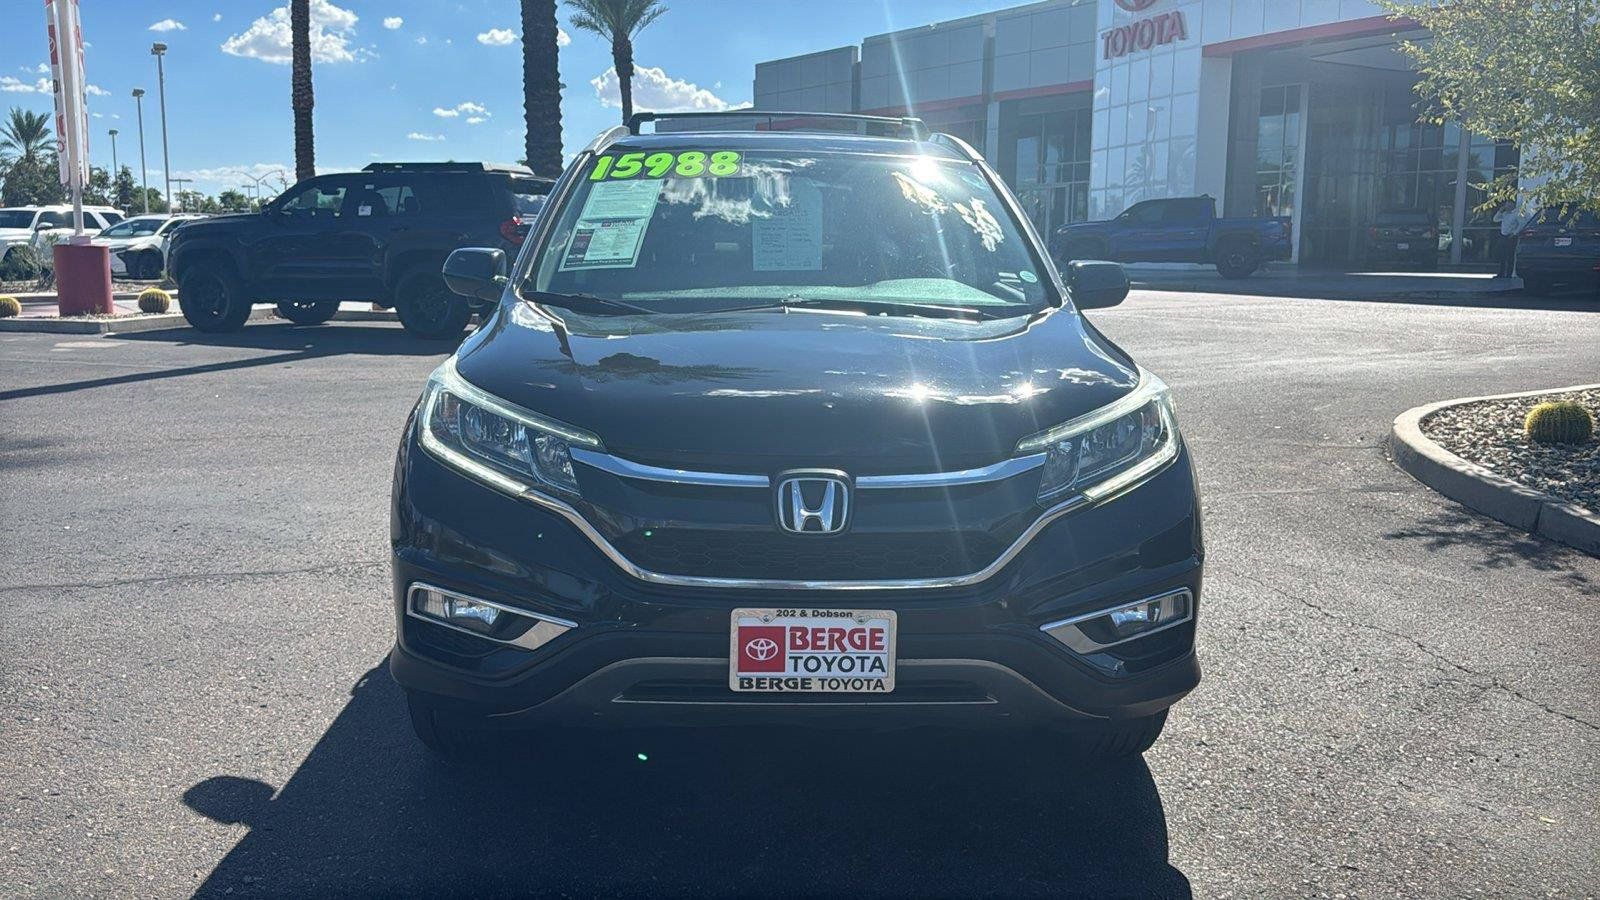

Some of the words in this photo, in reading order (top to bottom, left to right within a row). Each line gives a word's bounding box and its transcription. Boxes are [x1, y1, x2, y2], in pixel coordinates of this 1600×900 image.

[1101, 11, 1186, 60] TOYOTA
[589, 151, 742, 181] 15988
[776, 609, 796, 618] 202
[799, 610, 808, 618] &
[811, 609, 853, 618] Dobson
[789, 626, 885, 653] BERGE
[788, 655, 886, 673] TOYOTA
[739, 677, 812, 690] BERGE
[818, 678, 886, 691] TOYOTA
